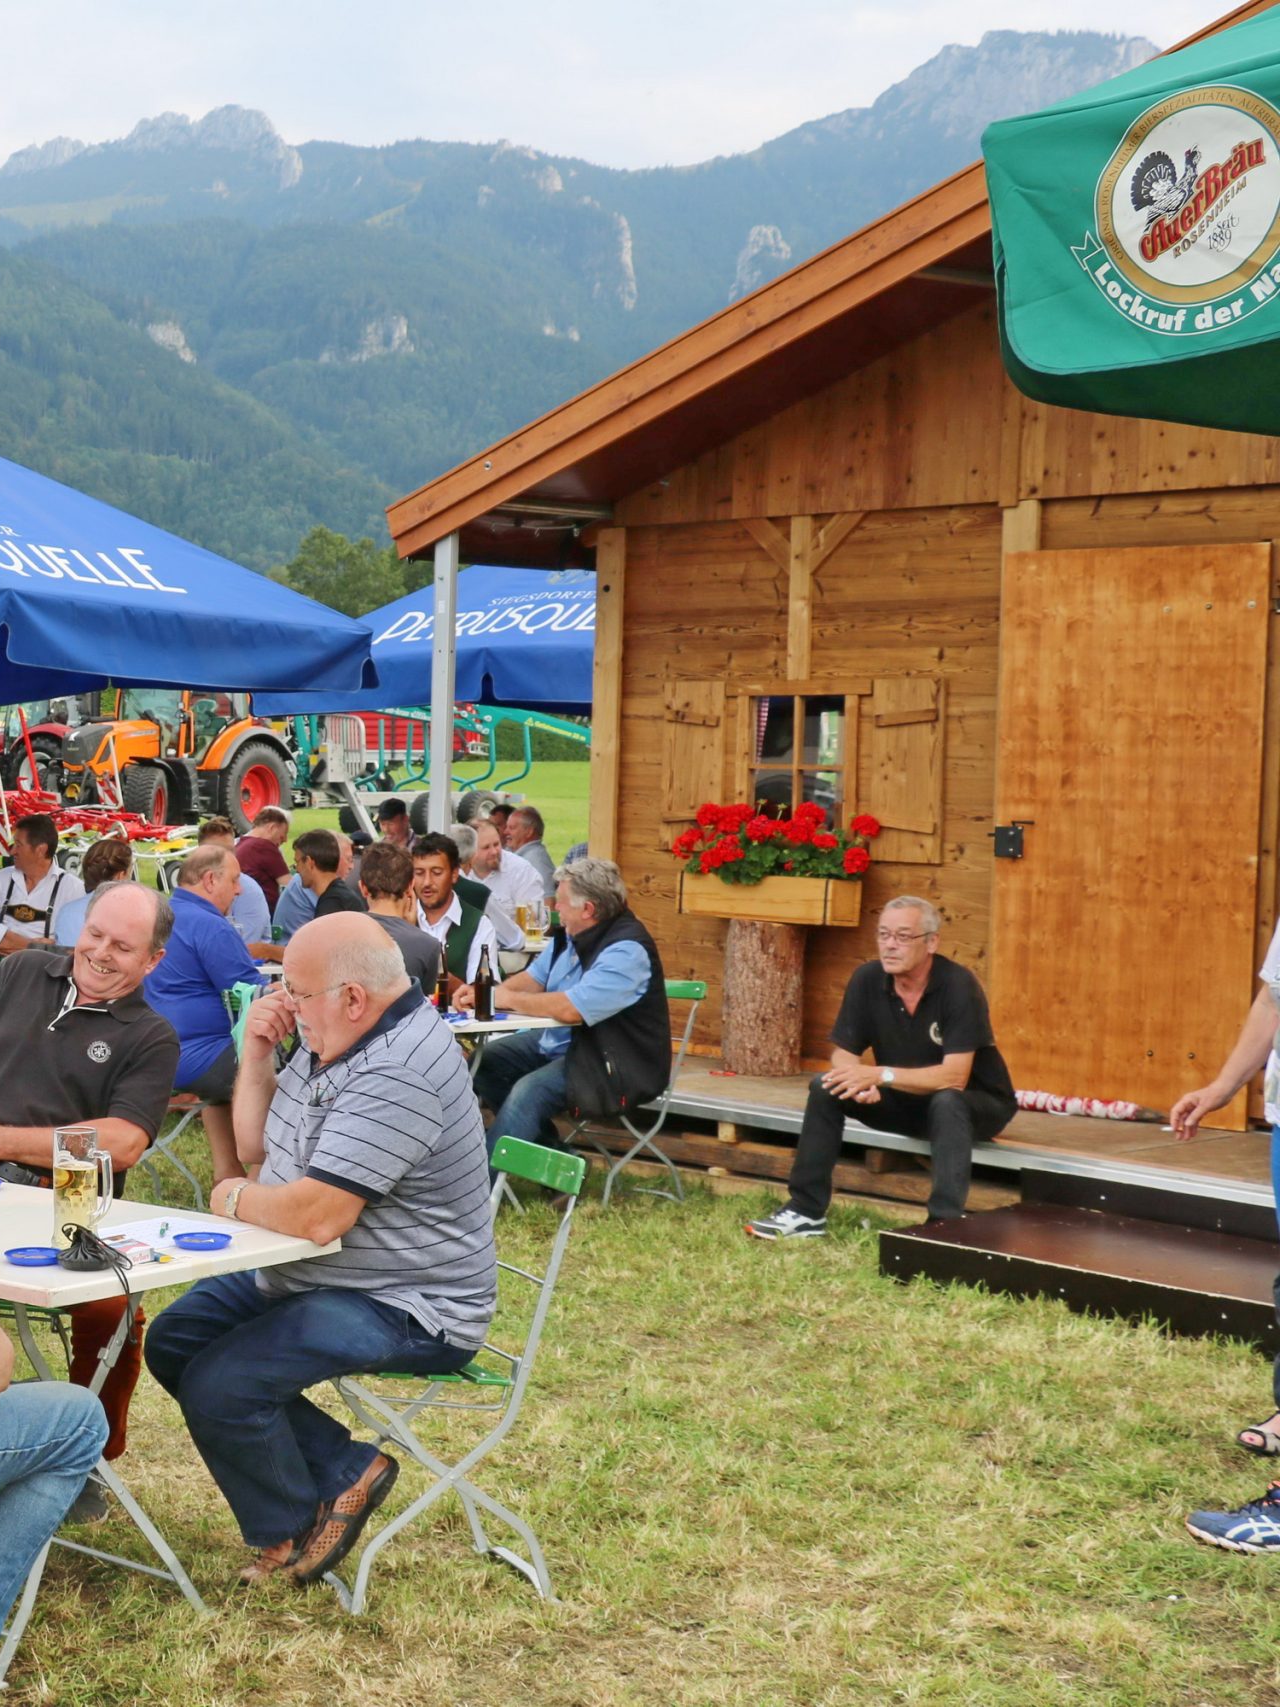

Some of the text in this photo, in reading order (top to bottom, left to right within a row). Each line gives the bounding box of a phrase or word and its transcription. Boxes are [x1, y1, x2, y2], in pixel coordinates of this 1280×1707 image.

[1173, 176, 1247, 259] ROSENHEIM
[1206, 226, 1232, 252] 1889
[1094, 262, 1187, 331] Lockruf
[1195, 298, 1244, 329] der
